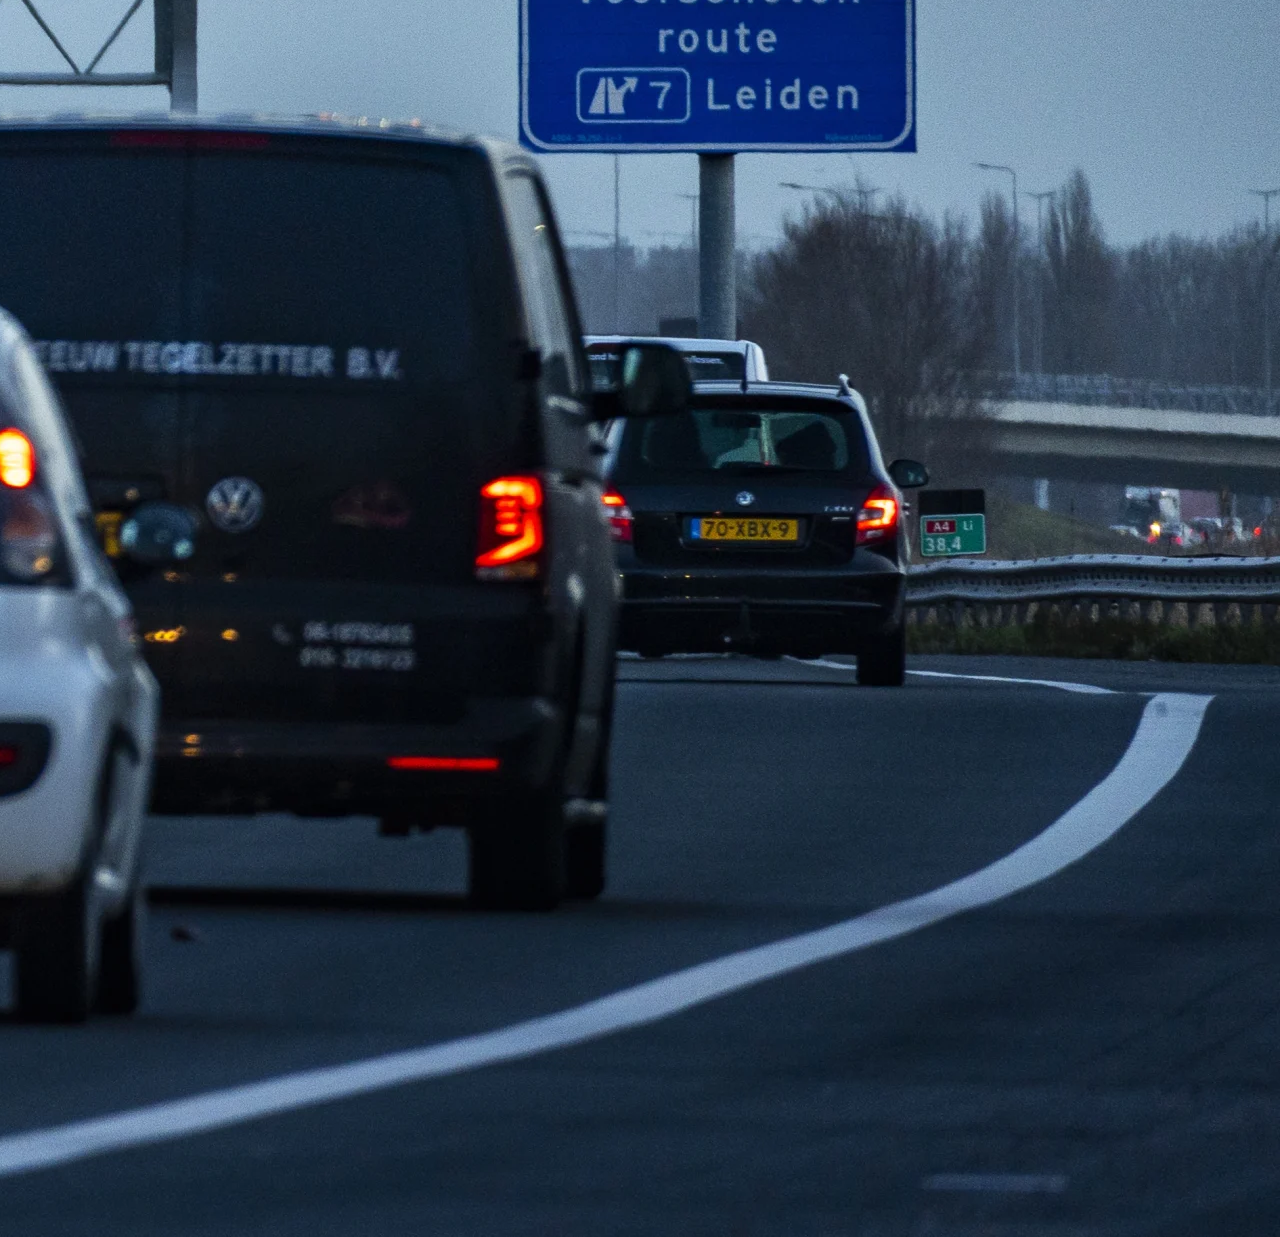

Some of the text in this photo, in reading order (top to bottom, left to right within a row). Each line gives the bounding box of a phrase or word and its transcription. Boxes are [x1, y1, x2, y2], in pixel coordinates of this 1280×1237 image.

[657, 21, 779, 55] route
[648, 77, 860, 112] 7 Leiden
[123, 340, 334, 378] TEGELZETTER
[703, 520, 790, 538] 70-XBX-9
[933, 520, 974, 532] A4 Li
